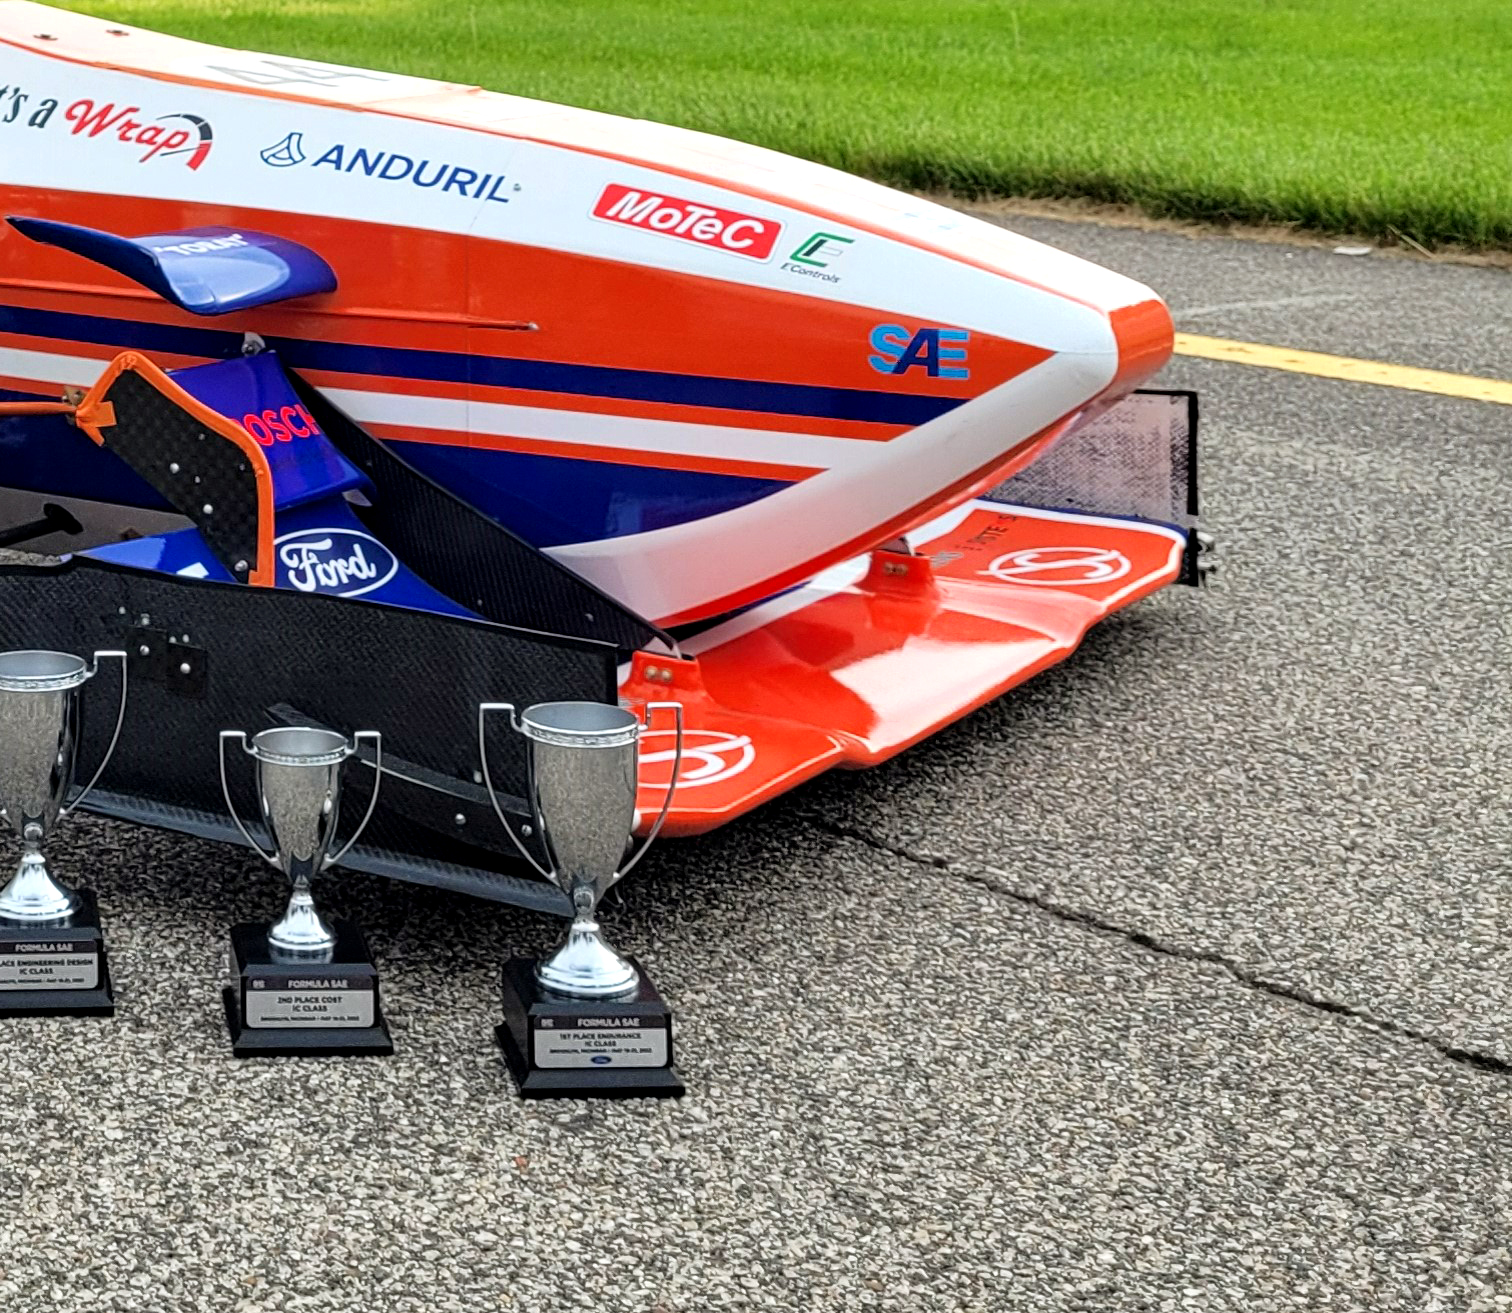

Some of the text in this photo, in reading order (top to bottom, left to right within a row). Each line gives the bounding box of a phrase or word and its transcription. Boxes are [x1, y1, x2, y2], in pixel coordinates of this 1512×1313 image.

[28, 99, 58, 128] a
[64, 99, 191, 163] Wrap
[311, 144, 509, 203] ANDURIL
[605, 191, 765, 249] MoTeC
[868, 323, 971, 379] SAE
[236, 404, 320, 445] OSCH
[280, 538, 376, 592] Ford
[15, 944, 55, 952] FORMULA
[288, 980, 330, 988] FORMULA
[577, 1018, 621, 1027] FORMULA
